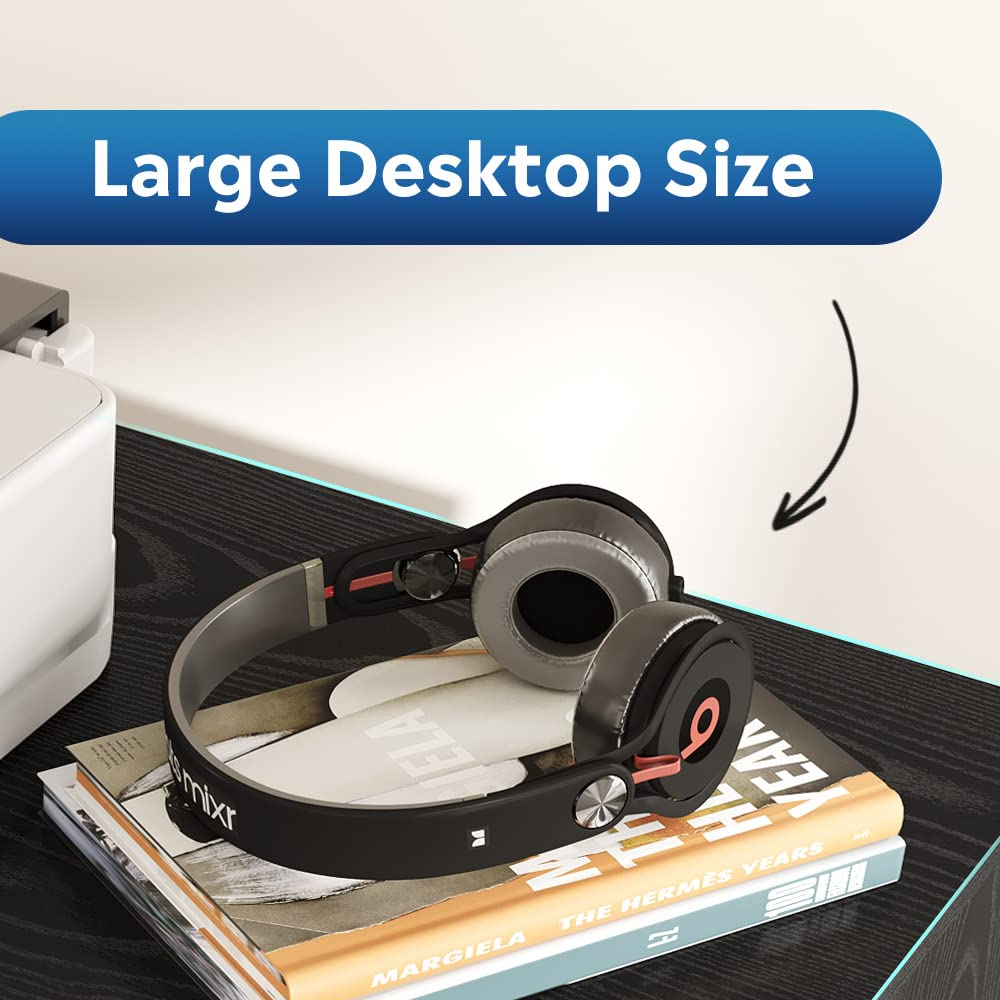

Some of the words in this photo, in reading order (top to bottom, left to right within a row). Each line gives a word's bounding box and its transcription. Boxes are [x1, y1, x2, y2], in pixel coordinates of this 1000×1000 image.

[370, 930, 527, 989] MARGIELA
[557, 904, 613, 931] THE
[620, 869, 734, 914] HERMÈS
[742, 841, 825, 876] YEARS
